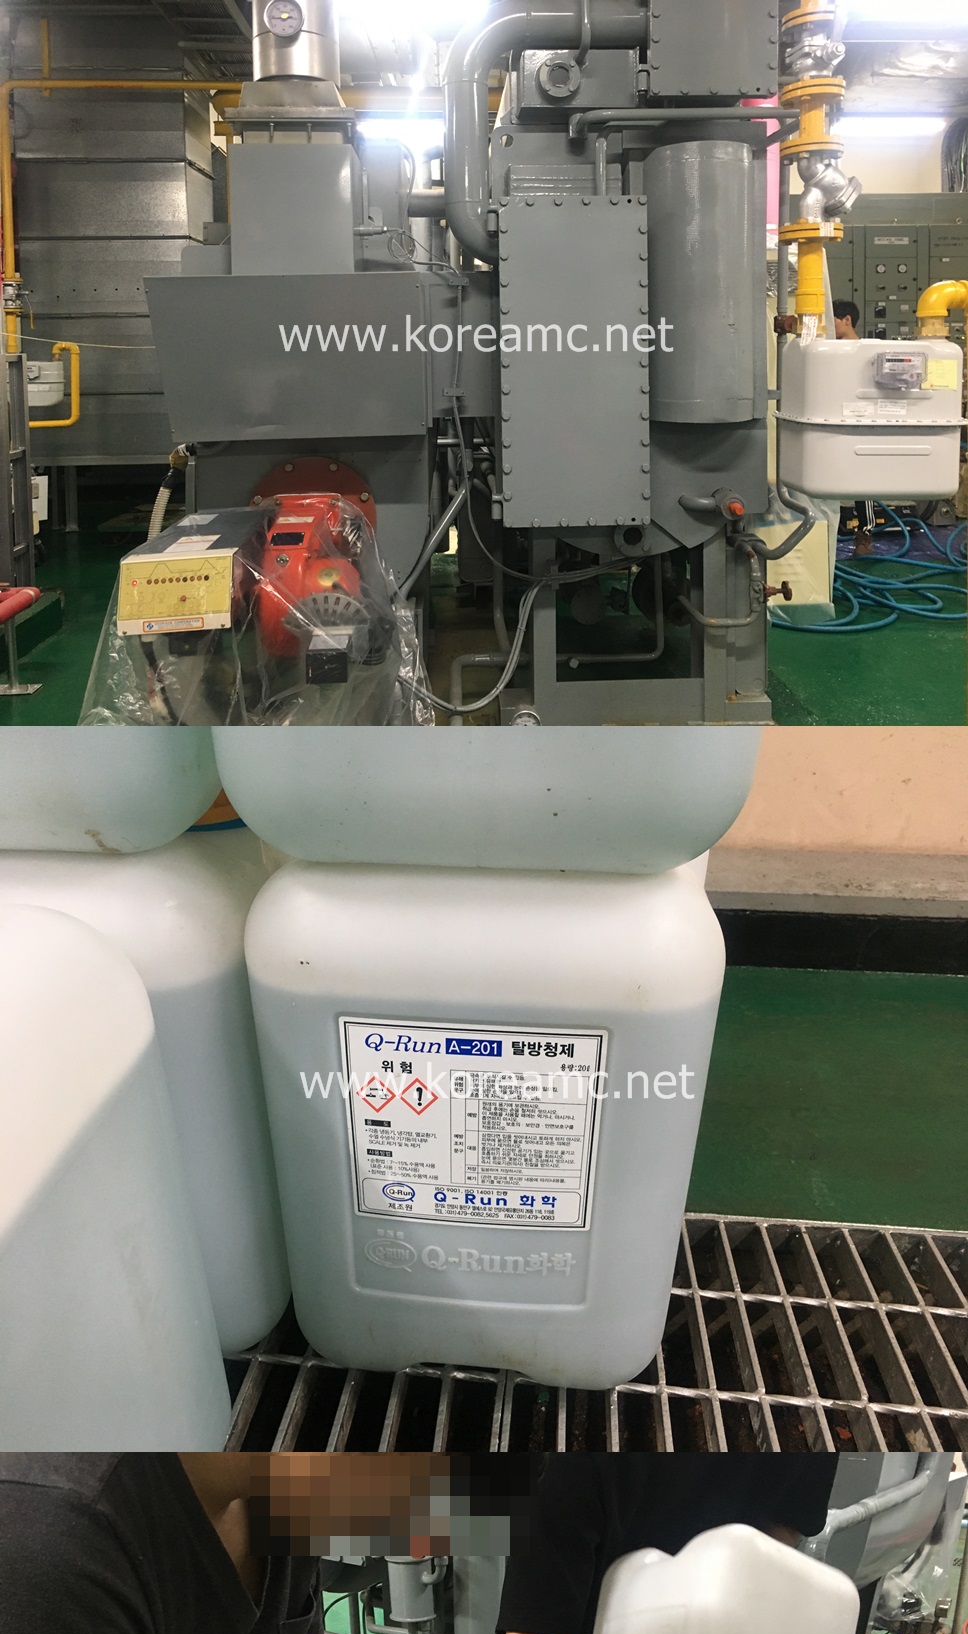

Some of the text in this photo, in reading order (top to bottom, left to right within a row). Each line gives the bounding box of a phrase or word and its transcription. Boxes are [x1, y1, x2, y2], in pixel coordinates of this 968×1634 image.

[364, 1032, 575, 1058] Q-Run A-201 탈방청제
